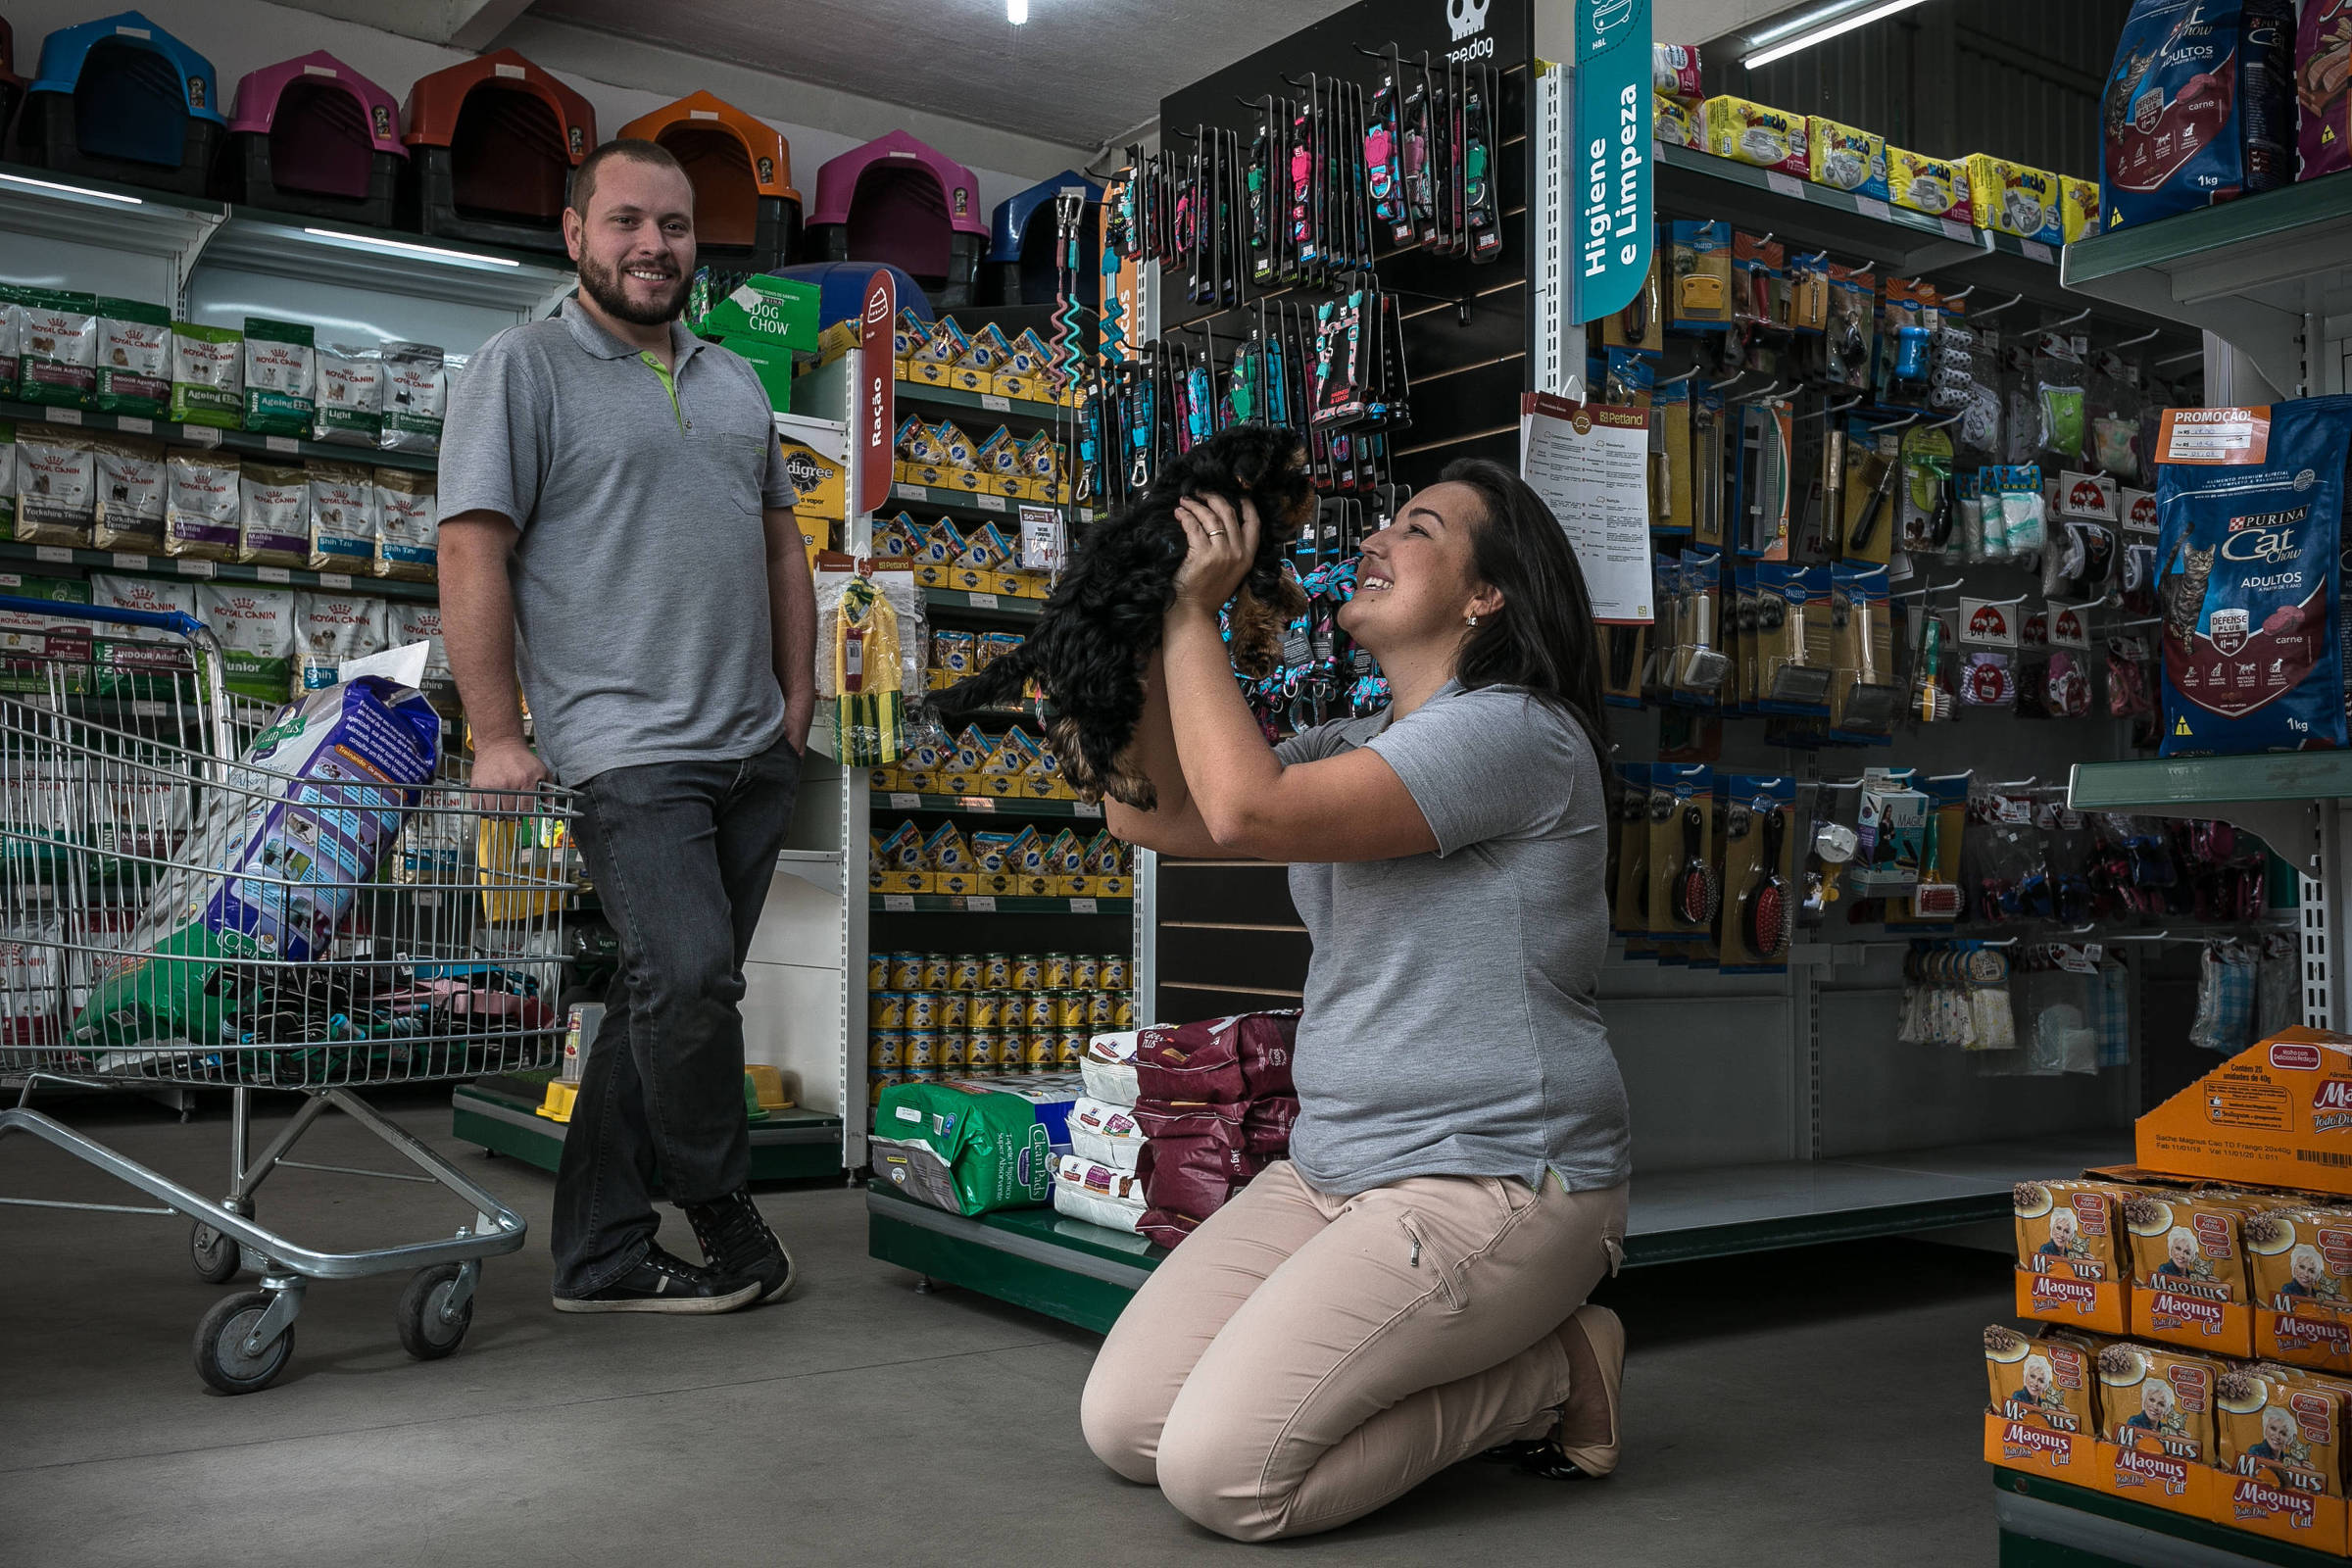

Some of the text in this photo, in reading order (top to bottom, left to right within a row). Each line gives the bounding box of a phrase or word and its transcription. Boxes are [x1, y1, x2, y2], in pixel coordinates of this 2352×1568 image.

[1592, 37, 1606, 50] H&L
[2188, 100, 2215, 111] carne
[1615, 83, 1642, 266] e Limpeza
[2198, 175, 2218, 186] 1kg
[1585, 138, 1612, 277] Higiene
[1254, 268, 1270, 278] COLLAR
[752, 303, 779, 319] DOG
[750, 317, 790, 335] CHOW
[187, 389, 221, 403] Ageing
[261, 396, 293, 409] Ageing
[328, 409, 352, 420] Light
[871, 376, 883, 448] Ração
[1609, 412, 1643, 426] Petland
[2175, 408, 2252, 423] PROMOÇÃO!
[787, 461, 834, 478] digree
[24, 507, 62, 519] Yorkshire
[2246, 508, 2305, 526] PURINA
[319, 537, 335, 547] Shih
[2222, 528, 2295, 561] Cat
[2266, 548, 2302, 564] Chow
[886, 561, 909, 569] Petland
[2241, 571, 2302, 588] ADULTOS
[113, 596, 176, 612] ROYAL CANIN
[215, 607, 276, 620] ROYAL CANIN
[310, 613, 339, 624] ROYAL
[2213, 614, 2247, 625] DEFENSE
[2286, 717, 2308, 732] 1kg
[2230, 1064, 2253, 1073] Contém
[2260, 1075, 2272, 1084] 40g
[2314, 1115, 2336, 1128] Todo
[2236, 1143, 2262, 1152] Frango
[1032, 1129, 1046, 1198] Clean Pads
[2032, 1278, 2093, 1301] Magnus
[2077, 1297, 2095, 1315] Cat
[2151, 1295, 2221, 1320] Magnus
[2202, 1317, 2222, 1336] Cat
[2274, 1316, 2348, 1343] Magnus
[2329, 1338, 2350, 1356] Cat
[2003, 1424, 2070, 1451] Magnus
[2050, 1448, 2071, 1467] Cat
[2115, 1450, 2185, 1478] Magnus
[2165, 1476, 2186, 1495] Cat
[2233, 1482, 2312, 1512] Magnus
